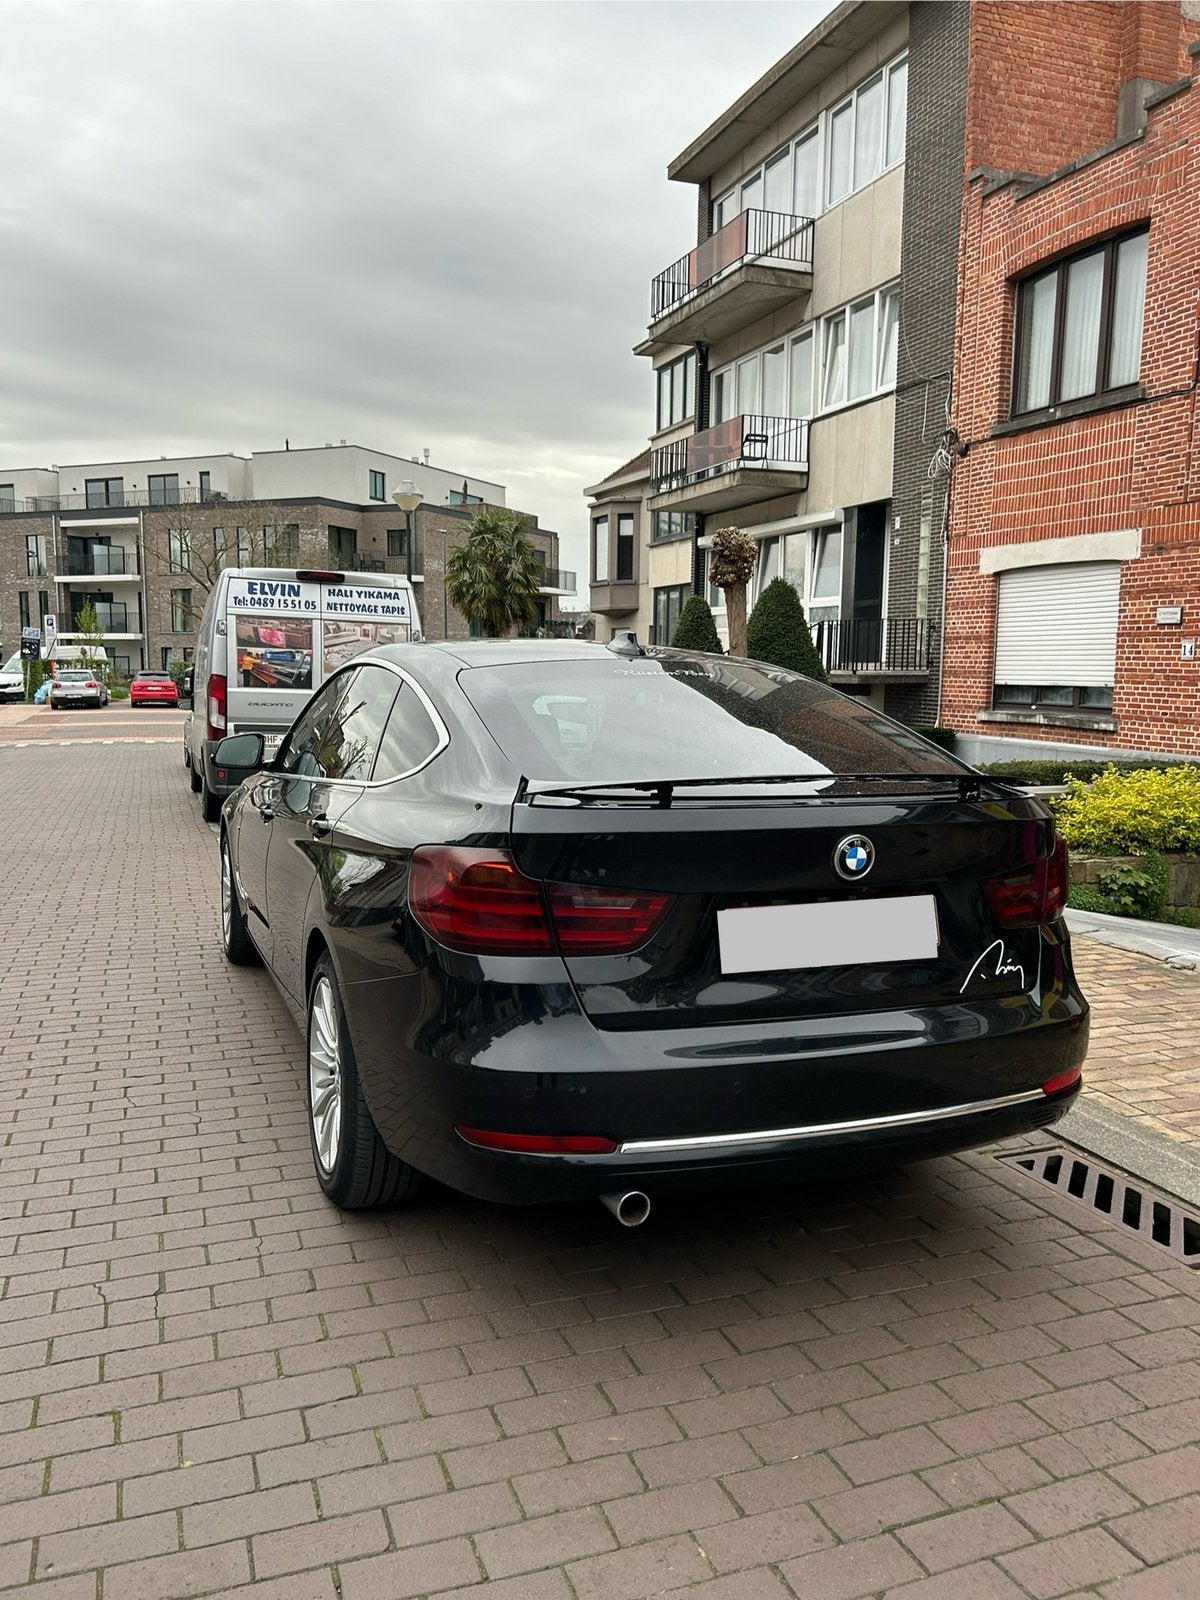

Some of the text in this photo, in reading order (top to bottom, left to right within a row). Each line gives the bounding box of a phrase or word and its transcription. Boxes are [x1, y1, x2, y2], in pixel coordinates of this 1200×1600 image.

[248, 581, 301, 598] ELVIN
[328, 588, 400, 601] HALI YIKAMA
[304, 600, 317, 610] 05
[326, 602, 406, 616] NETTOYAGE TAPIS
[1183, 645, 1193, 655] 14
